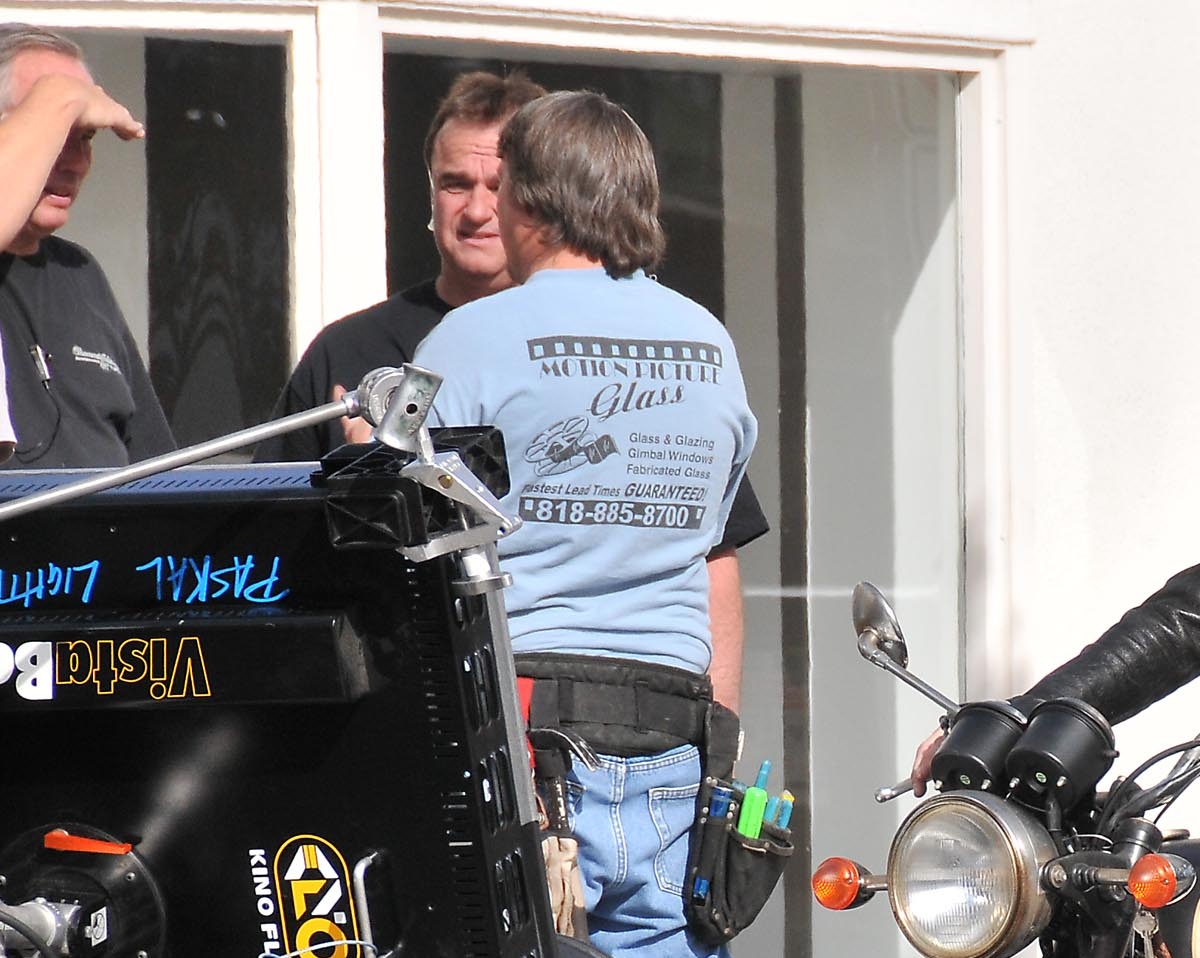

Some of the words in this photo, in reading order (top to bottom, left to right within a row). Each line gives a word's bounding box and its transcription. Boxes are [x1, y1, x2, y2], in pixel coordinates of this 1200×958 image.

[540, 358, 629, 378] MOTION
[635, 361, 721, 385] PICTURE
[587, 381, 685, 422] Glass
[629, 432, 662, 445] Glass
[664, 434, 672, 445] &
[674, 435, 715, 452] Glazing
[627, 448, 666, 461] Gimbal
[669, 451, 714, 465] Windows
[626, 464, 681, 477] Fabricated
[684, 467, 711, 480] Glass
[565, 483, 591, 496] Lead
[593, 484, 620, 497] Times
[624, 482, 709, 502] GUARANTEED!
[536, 502, 689, 527] 818-885-8700
[0, 560, 100, 607] LIGHT
[136, 555, 291, 604] PASKAL
[249, 849, 275, 917] KINO
